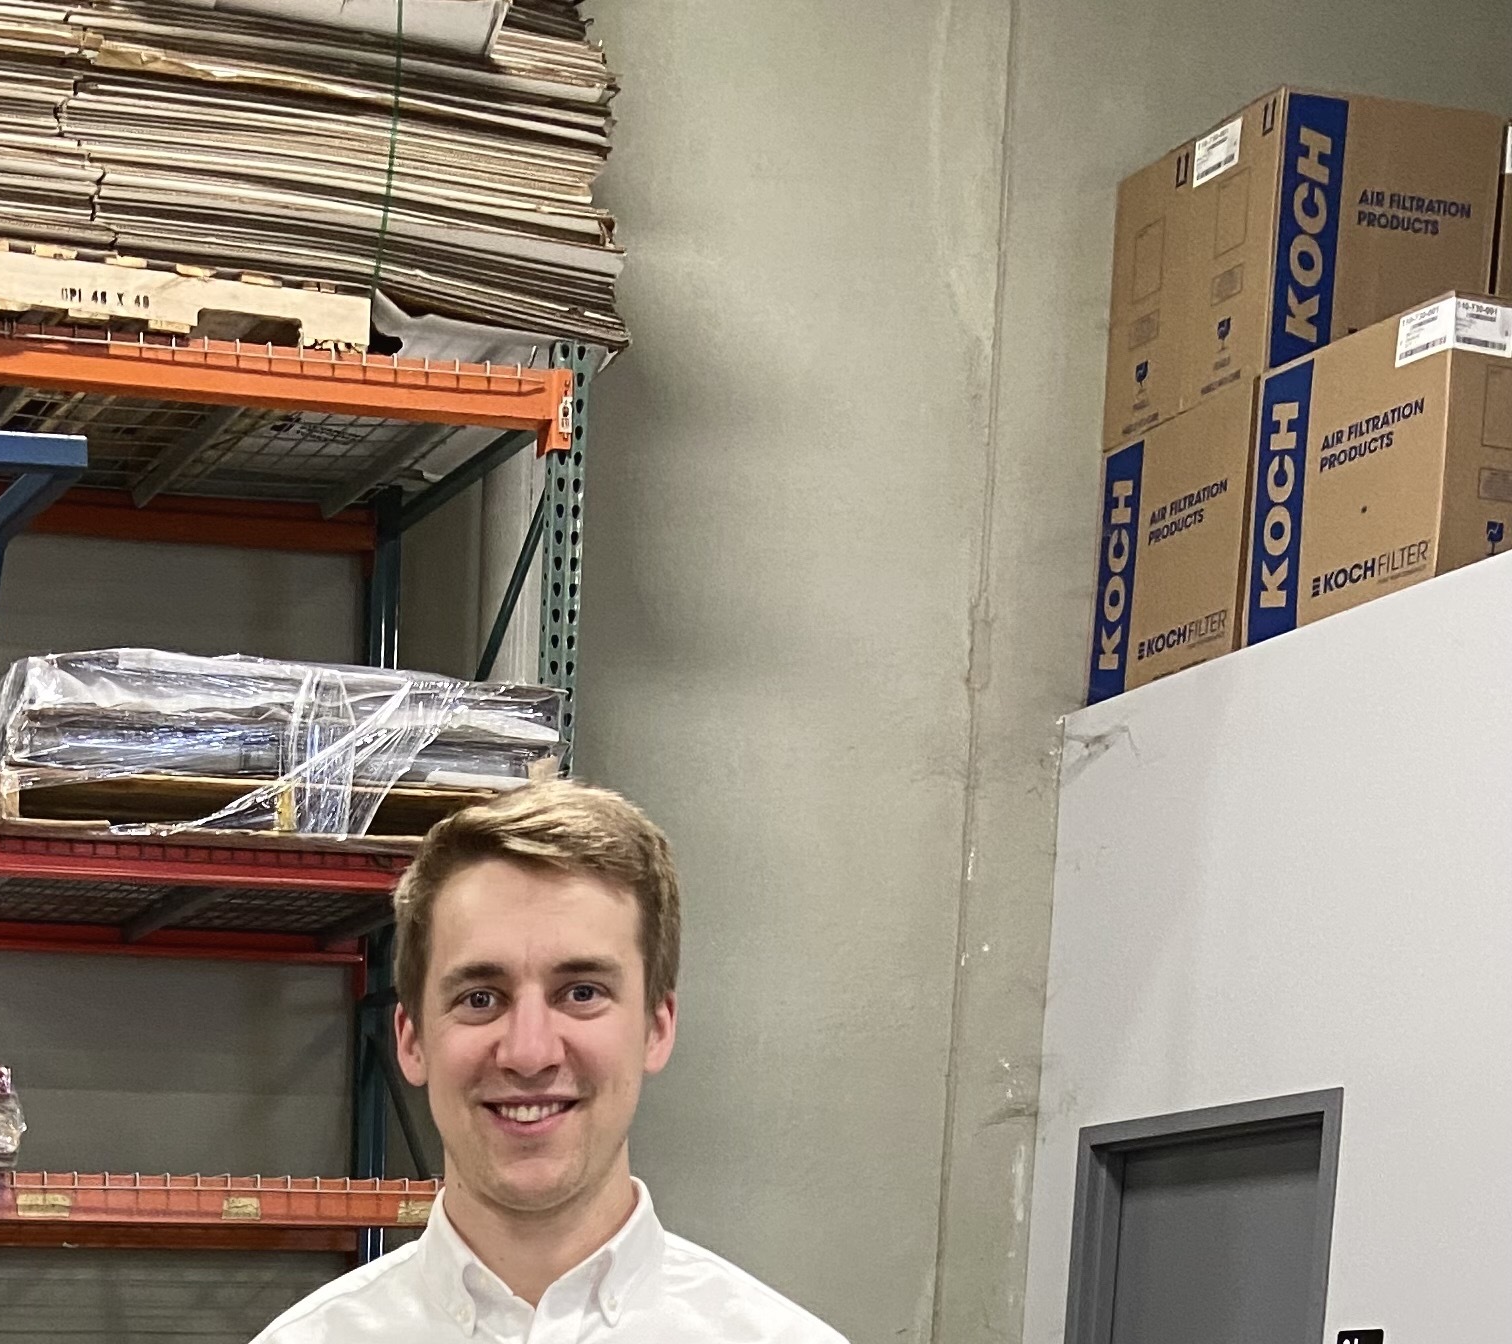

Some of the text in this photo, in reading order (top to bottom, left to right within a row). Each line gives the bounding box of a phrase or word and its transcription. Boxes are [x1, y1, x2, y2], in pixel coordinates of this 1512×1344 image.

[1357, 210, 1439, 236] PRODUCTS
[1358, 189, 1471, 219] AIR FILTRATION
[1284, 125, 1332, 343] KOCH
[1320, 397, 1425, 452] AIR FILTRATION
[1319, 431, 1394, 473] PRODUCTS
[1148, 508, 1204, 546] PRODUCTS
[1150, 478, 1228, 527] AIR FILTRATION
[1259, 401, 1299, 608] KOCH
[1098, 480, 1133, 670] KOCH
